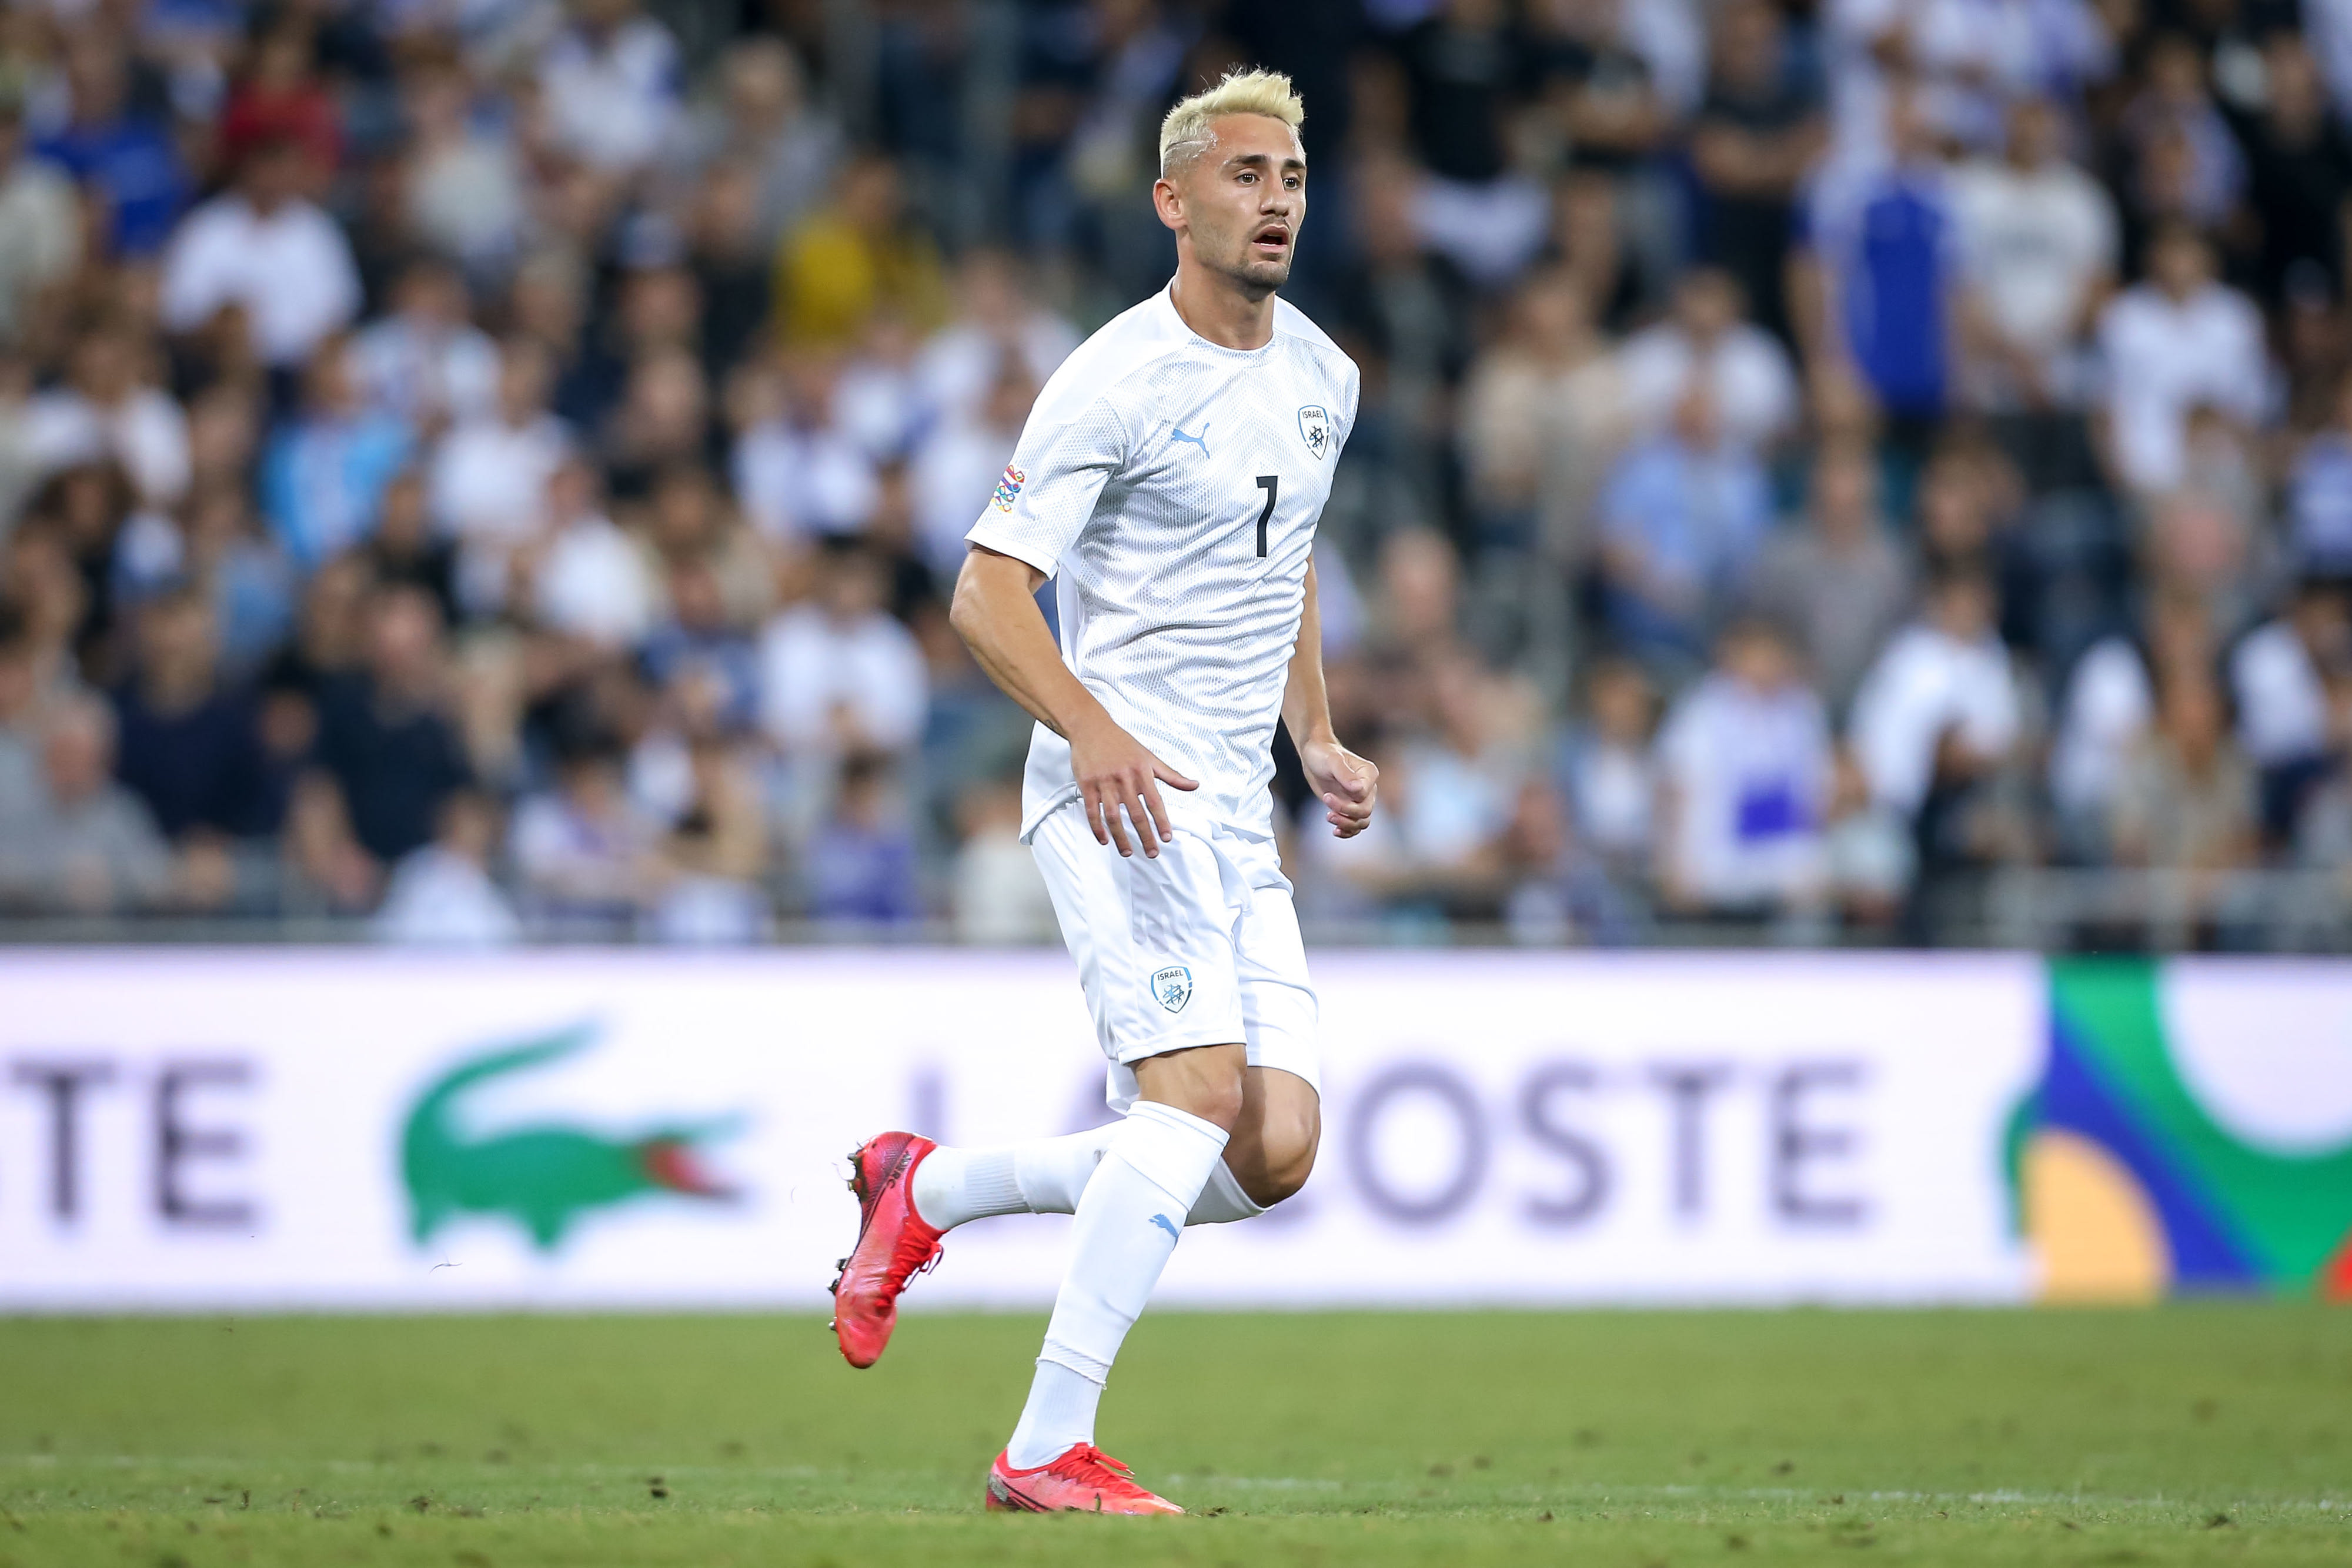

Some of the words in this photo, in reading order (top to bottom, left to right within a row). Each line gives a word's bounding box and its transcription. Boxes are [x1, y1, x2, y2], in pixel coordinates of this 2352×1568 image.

[1302, 410, 1324, 419] ISRAEL
[1256, 476, 1278, 557] 7
[1157, 969, 1184, 981] ISRAEL
